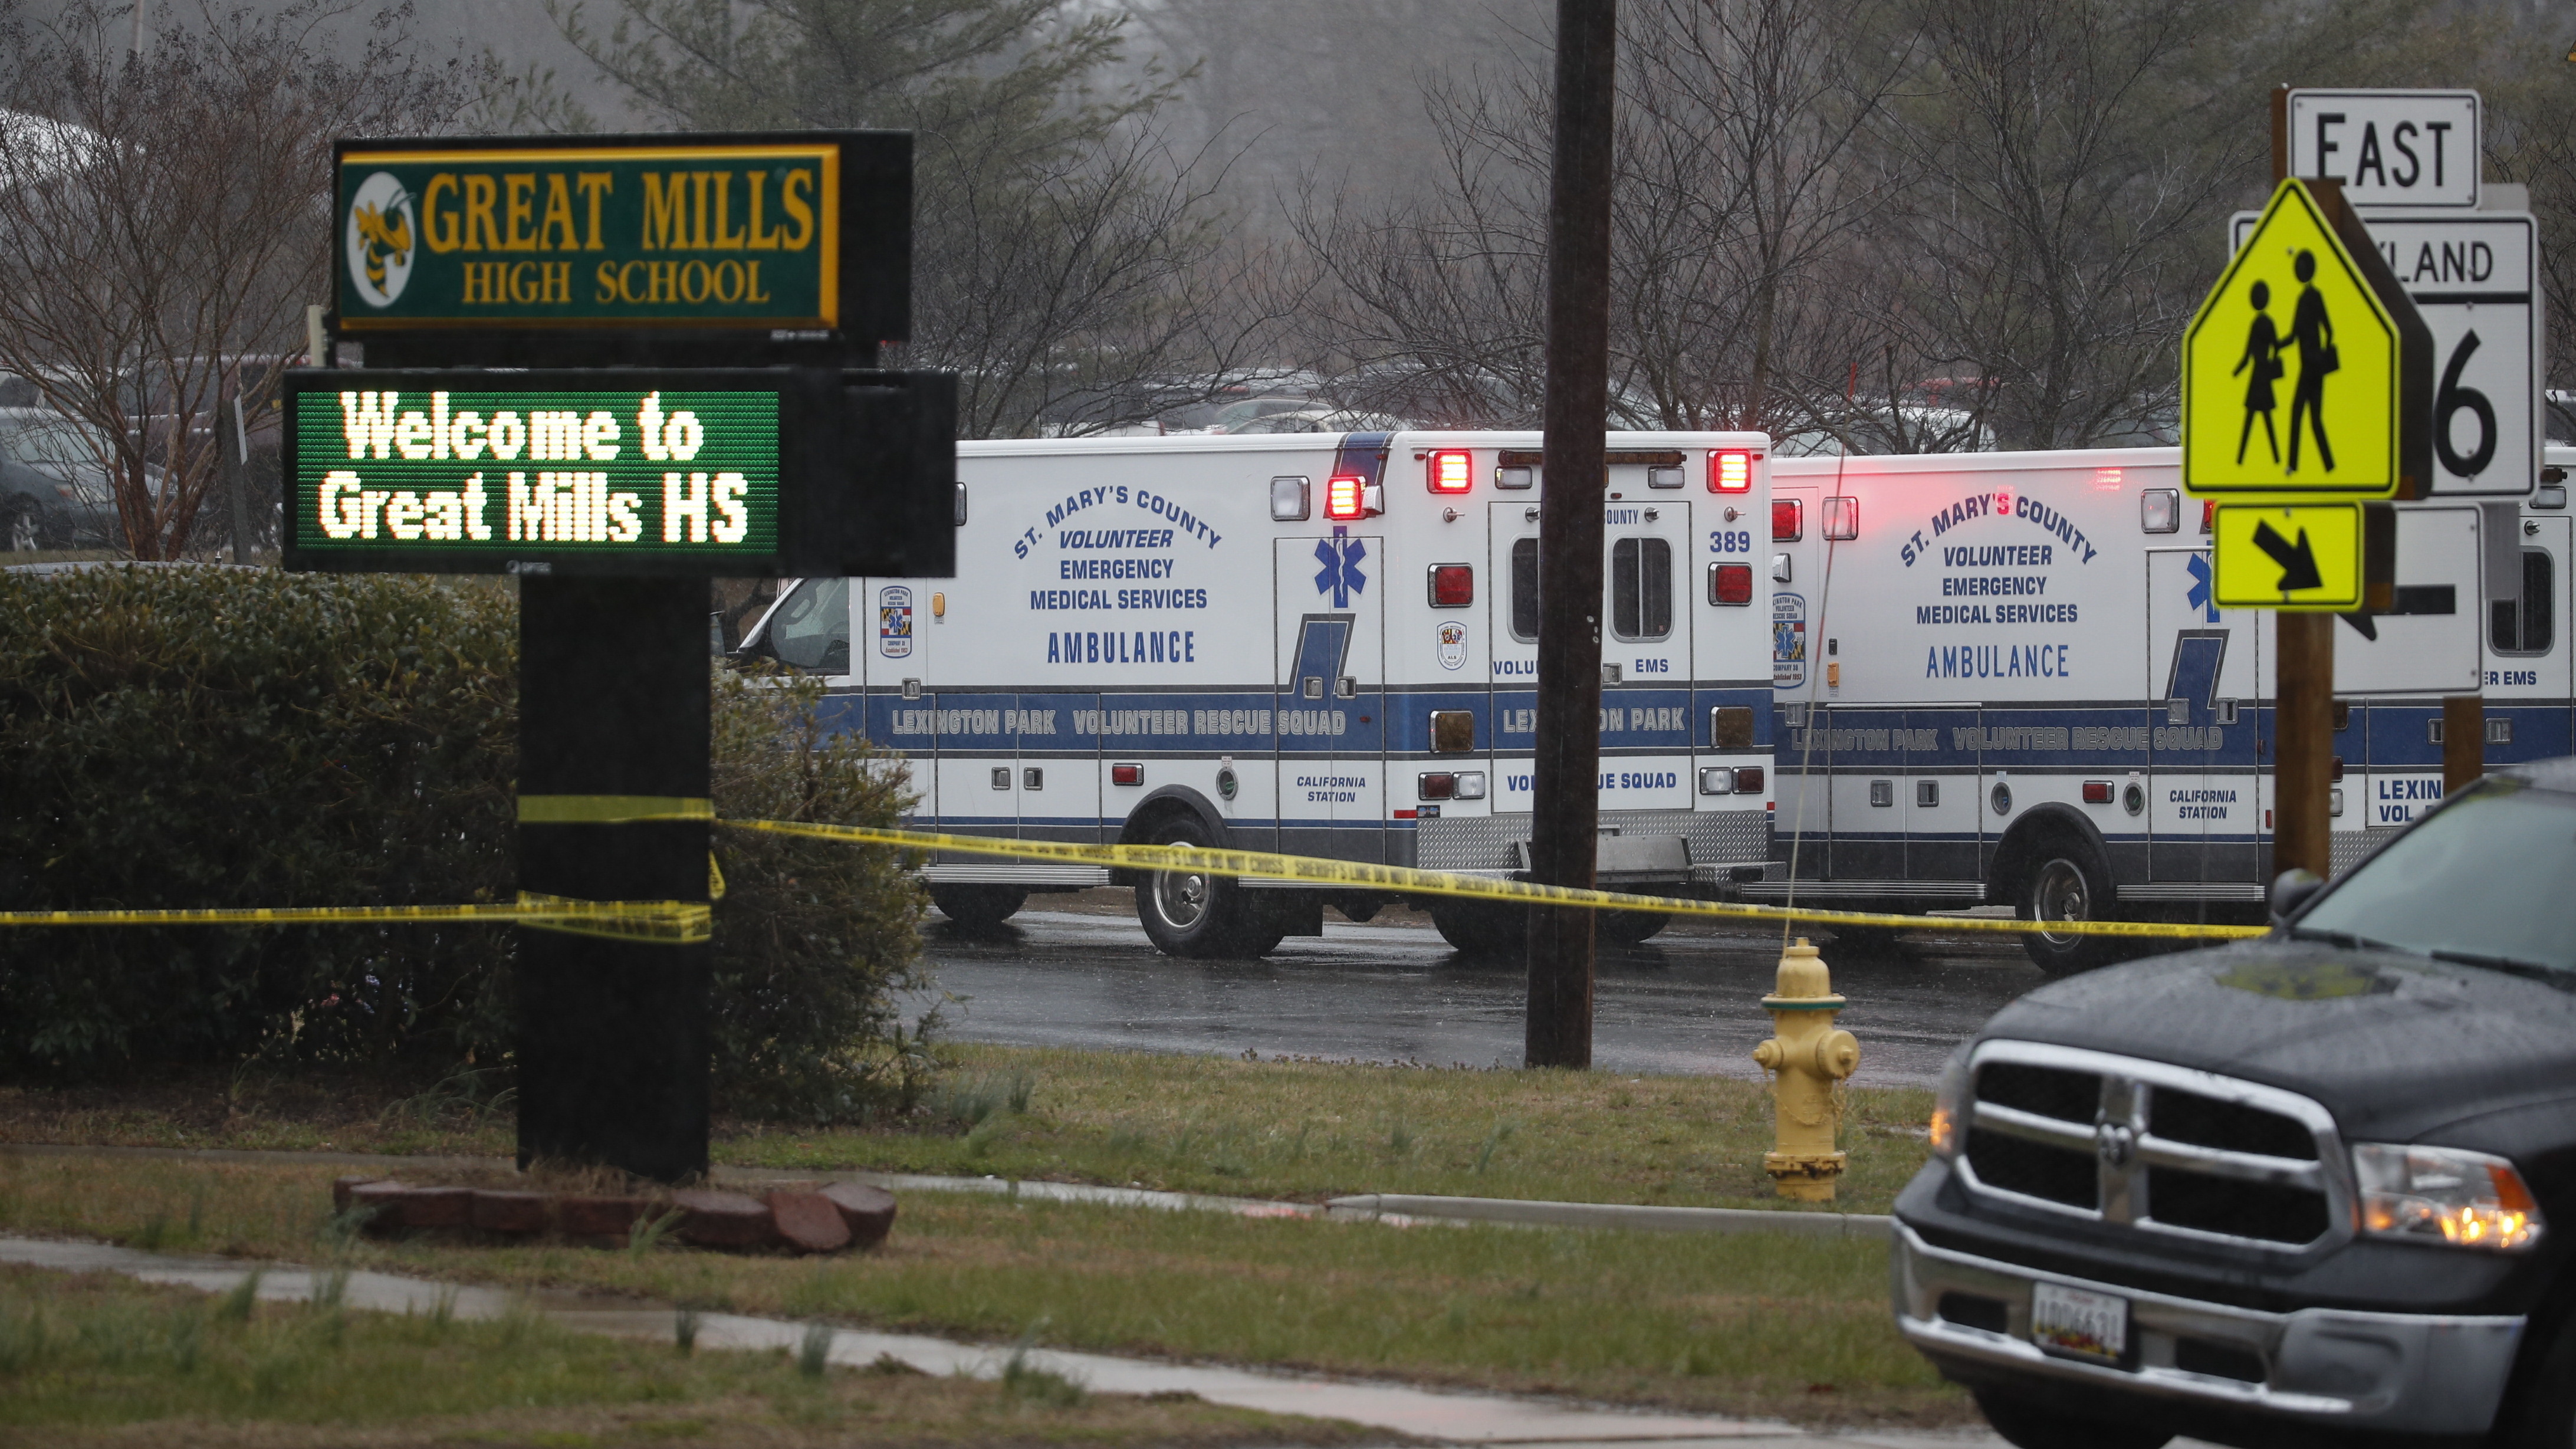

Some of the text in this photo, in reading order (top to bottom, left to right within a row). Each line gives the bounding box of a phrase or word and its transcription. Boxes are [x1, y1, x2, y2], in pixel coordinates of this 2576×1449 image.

[2317, 113, 2452, 188] EAST
[422, 169, 815, 253] GREAT MILLS
[2380, 241, 2493, 282] LAND
[462, 259, 770, 304] HIGH SCHOOL
[340, 390, 704, 460] Welcome to
[319, 471, 748, 544] Great Mills HS
[1605, 509, 1639, 524] OUNTY
[1014, 485, 1222, 560] ST. MARY'S COUNTY
[1900, 493, 2097, 567] ST. MARY'S COUNTY
[1060, 529, 1174, 549] VOLUNTEER
[1710, 531, 1750, 553] 389
[1943, 545, 2053, 567] VOLUNTEER
[1060, 558, 1174, 579] EMERGENCY
[1943, 576, 2047, 596] EMERGENCY
[1030, 588, 1207, 610] MEDICAL SERVICES
[1917, 604, 2078, 624] MEDICAL SERVICES
[1047, 630, 1195, 663] AMBULANCE
[1635, 658, 1669, 673] EMS
[1926, 644, 2069, 678] AMBULANCE
[2503, 671, 2537, 686] EMS
[892, 709, 1346, 736] LEXINGTON PARK VOLUNTEER RESCUE SQUAD
[1630, 707, 1685, 731] PARK
[1791, 726, 2223, 751] LEXINGTON PARK VOLUNTEER RESCUE SQUAD
[1296, 776, 1366, 788] CALIFORNIA
[1621, 772, 1677, 789] SQUAD
[2379, 780, 2442, 800] LEXIN
[1307, 790, 1356, 803] STATION
[2169, 789, 2237, 803] CALIFORNIA
[2179, 806, 2227, 819] STATION
